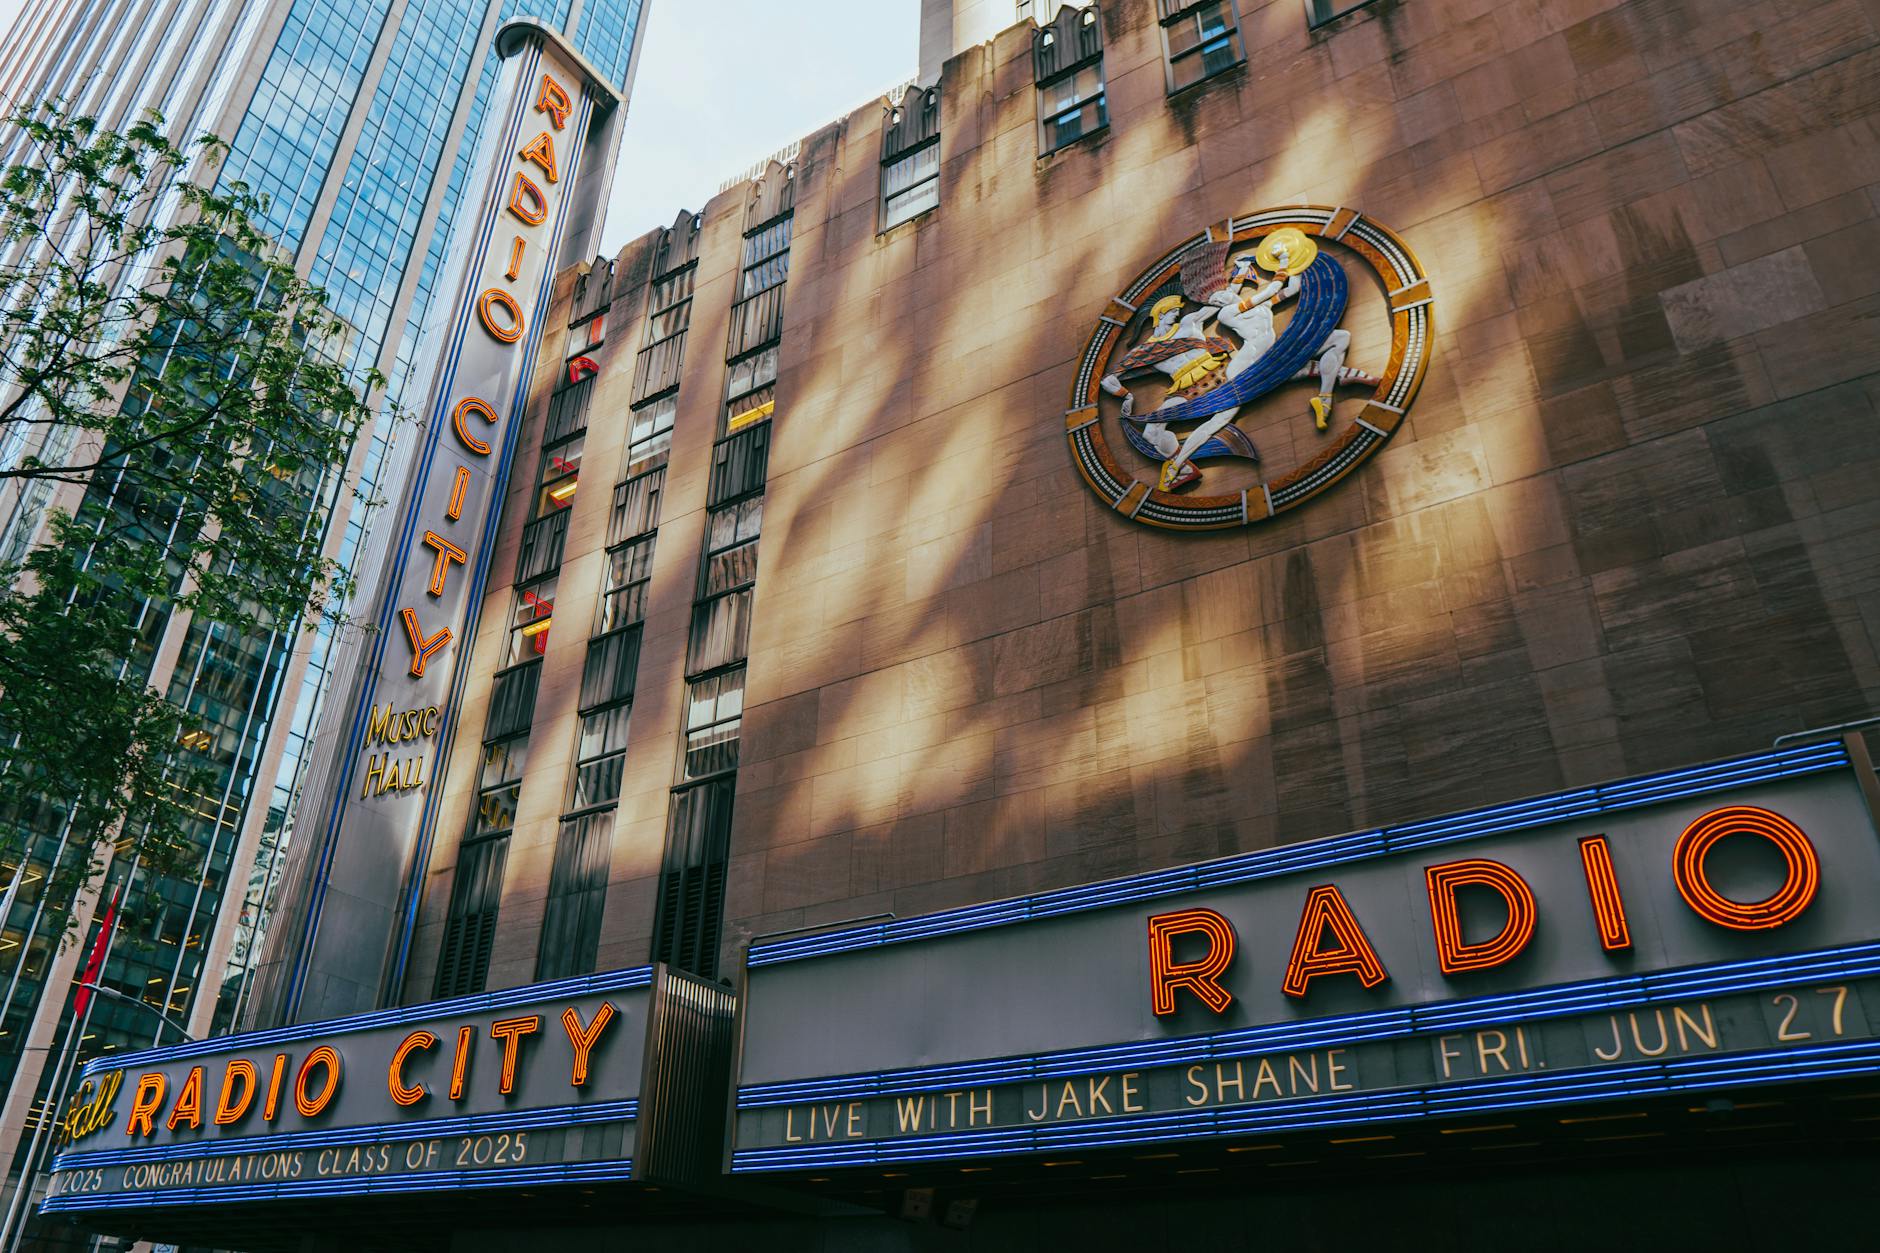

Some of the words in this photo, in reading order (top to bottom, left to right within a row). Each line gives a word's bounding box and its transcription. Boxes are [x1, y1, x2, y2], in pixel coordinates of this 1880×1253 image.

[478, 72, 573, 344] RADIO
[396, 396, 499, 681] CITY
[1147, 805, 1822, 1017] RADIO
[126, 1045, 342, 1138] RADIO
[387, 1001, 619, 1107] CITY
[786, 1102, 864, 1142] LIVE
[897, 1088, 993, 1133] WITH
[1028, 1072, 1143, 1121] JAKE
[1186, 1049, 1353, 1107] SHANE
[1439, 1026, 1547, 1078] FRI.
[1595, 1003, 1717, 1061] JUN
[1772, 986, 1848, 1041] 27
[60, 1168, 103, 1194] 2025
[122, 1152, 304, 1190] CONGRATULATIONS
[317, 1143, 391, 1176] CLASS
[405, 1139, 441, 1170] OF
[456, 1132, 527, 1167] 2025
